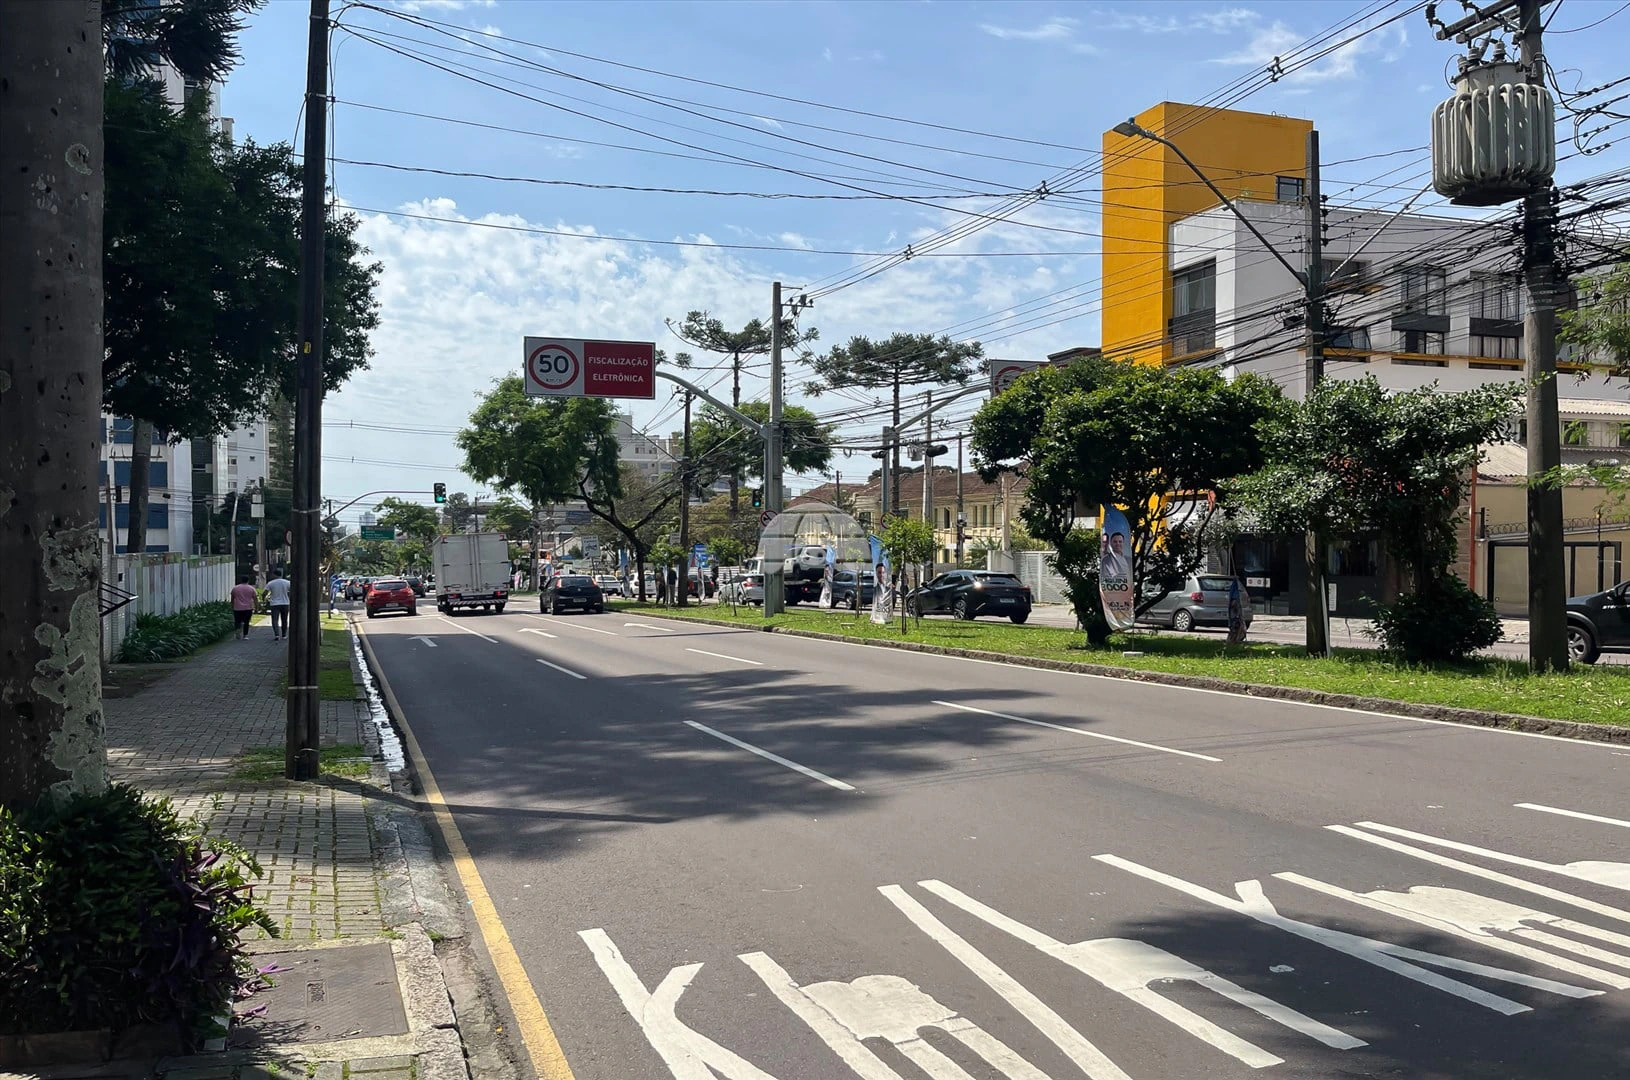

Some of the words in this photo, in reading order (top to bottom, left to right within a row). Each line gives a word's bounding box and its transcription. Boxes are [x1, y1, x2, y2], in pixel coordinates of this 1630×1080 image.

[539, 354, 569, 374] 50
[588, 356, 649, 367] FISCALIZAÇÃO
[593, 372, 645, 383] ELETRÔNICA
